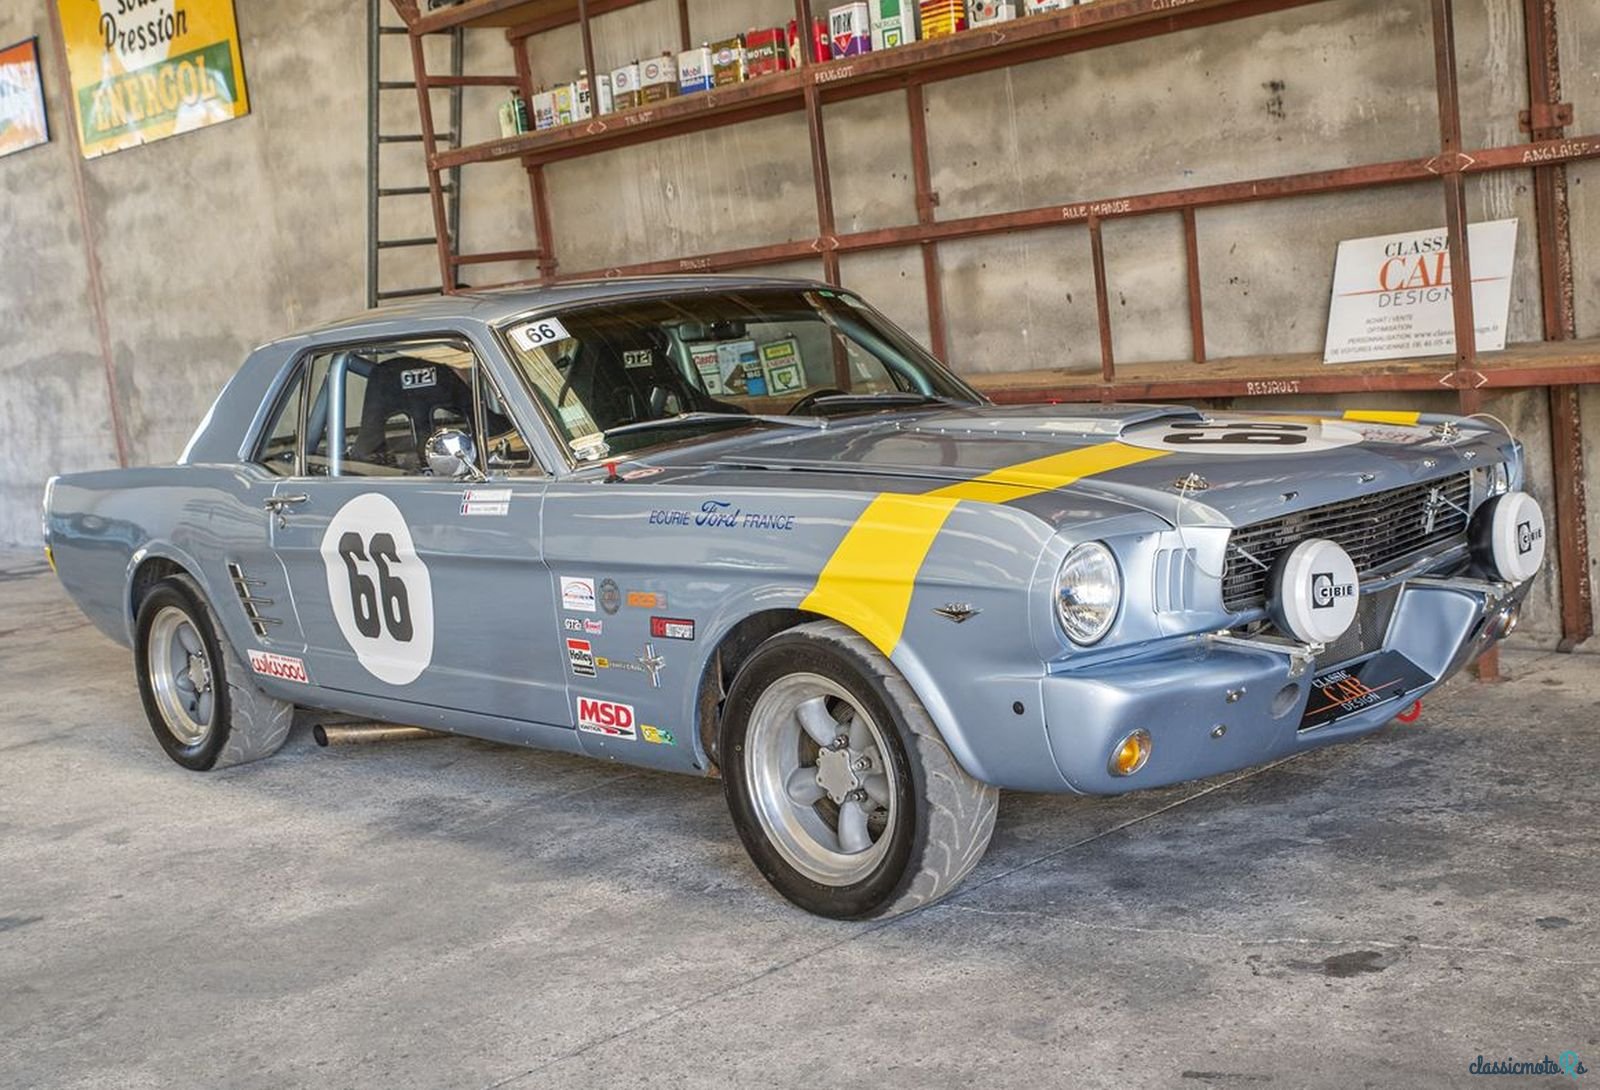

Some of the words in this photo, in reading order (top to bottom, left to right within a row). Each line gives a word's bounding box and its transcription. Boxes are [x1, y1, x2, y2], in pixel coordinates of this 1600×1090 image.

[99, 9, 187, 53] Pression
[747, 46, 773, 59] MOTUL
[682, 64, 702, 77] Mobil
[815, 66, 854, 84] PEUGEOT
[91, 55, 216, 132] ENERGOL
[524, 323, 556, 344] 66
[1246, 380, 1300, 396] RENAULT
[649, 510, 692, 526] ECURIE
[695, 500, 740, 527] Ford
[743, 513, 796, 530] FRANCE
[1522, 528, 1542, 545] CIBIE
[338, 531, 414, 642] 66
[1320, 585, 1353, 598] CIBIE
[251, 652, 306, 681] wilwood
[569, 650, 593, 666] Holley
[1312, 669, 1351, 689] CLASSIC
[1322, 675, 1373, 703] CAR
[1341, 692, 1381, 712] DESIGN
[580, 699, 632, 728] MSD
